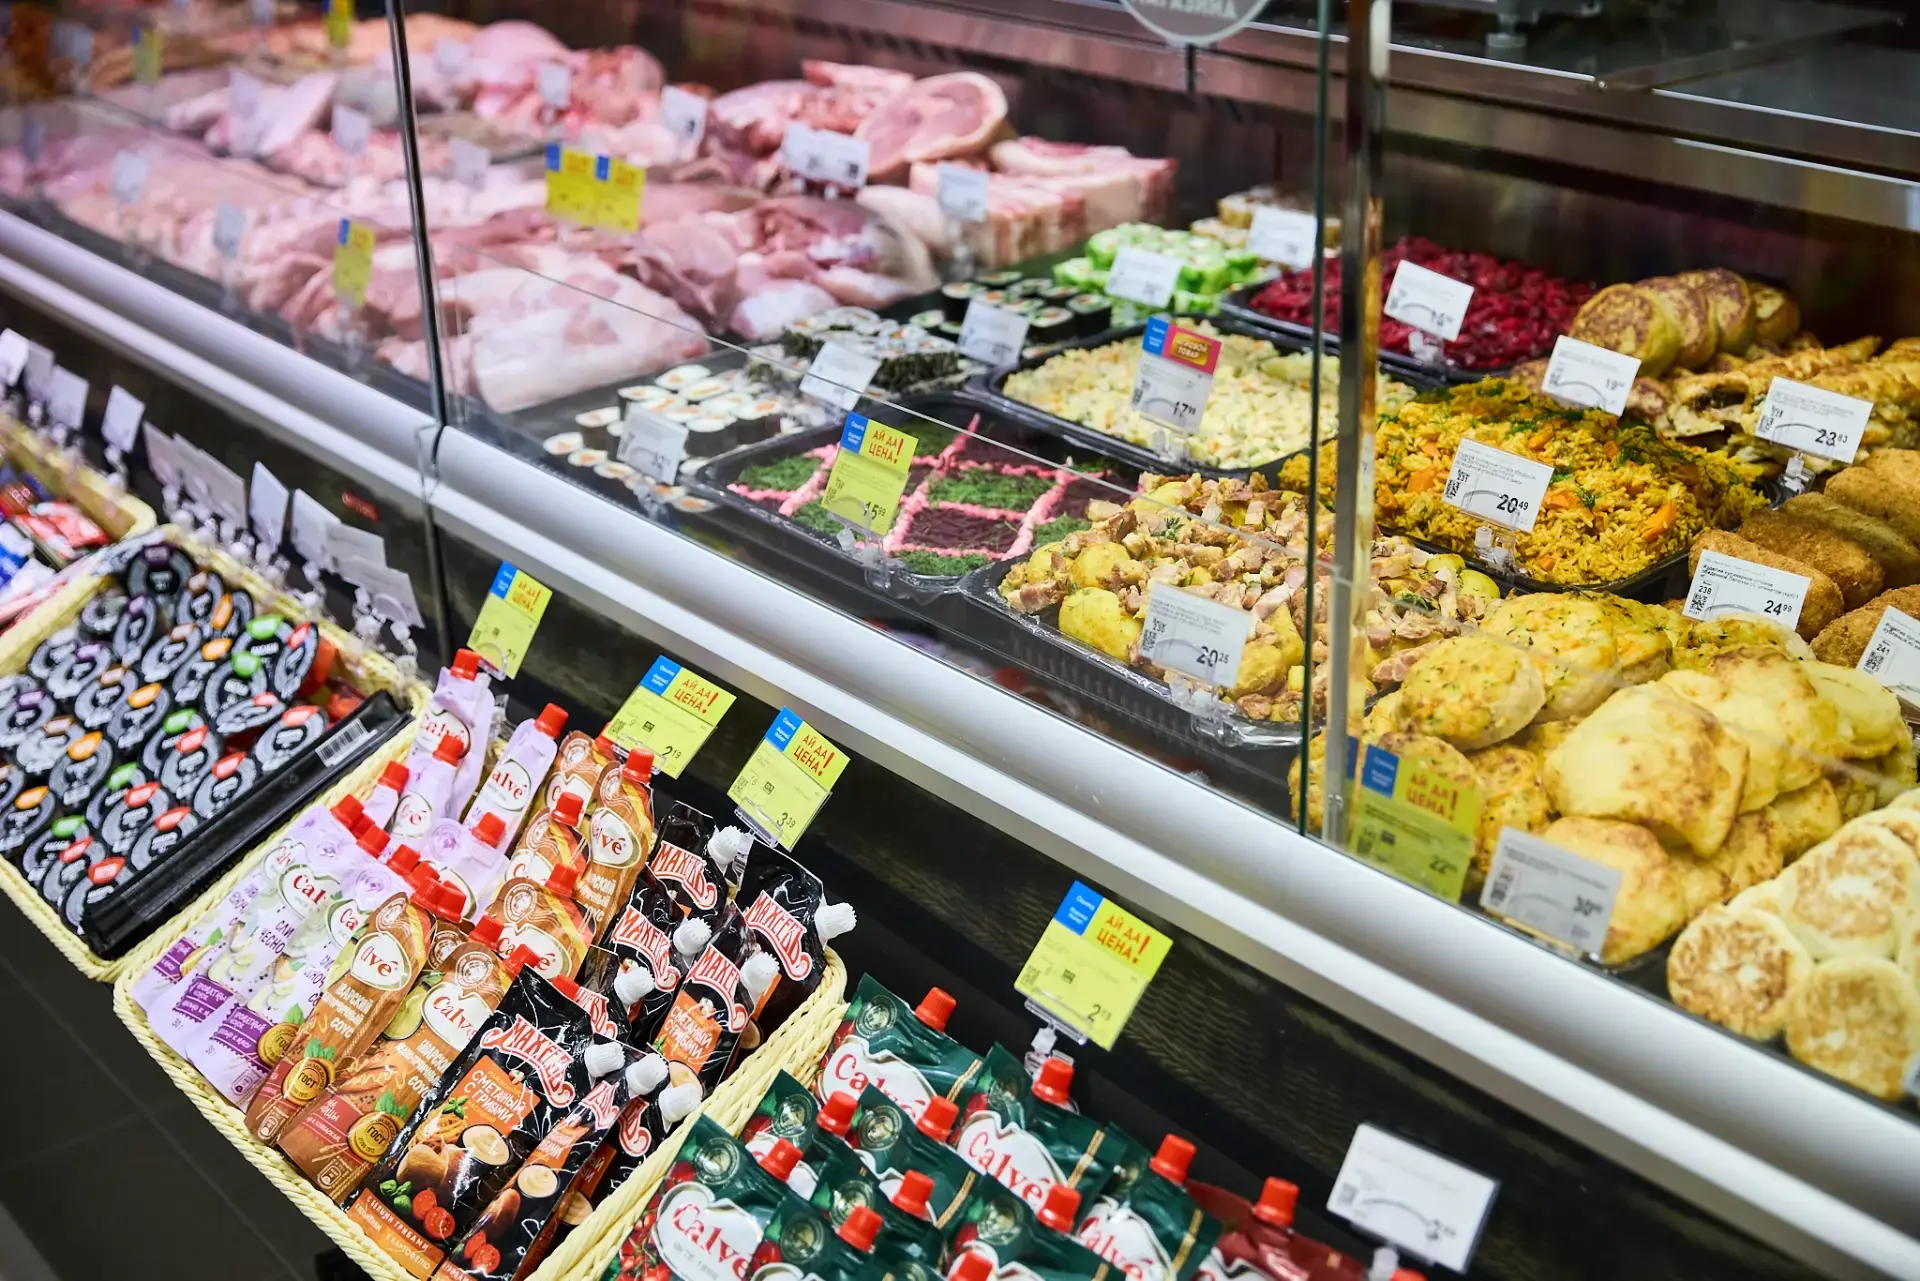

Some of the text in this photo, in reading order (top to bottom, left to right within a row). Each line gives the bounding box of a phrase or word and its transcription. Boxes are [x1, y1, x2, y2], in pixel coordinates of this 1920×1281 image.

[868, 438, 904, 464] ЦЕНА!
[873, 430, 886, 441] АЙ
[885, 436, 897, 447] ДА
[1698, 585, 1712, 595] 238
[1876, 643, 1890, 655] 241
[673, 689, 719, 714] ЦЕНА!
[683, 679, 711, 700] АЙ ДА
[802, 734, 828, 759] АЙ ДА
[793, 744, 835, 777] ЦЕНА!
[492, 772, 528, 800] alvé
[1106, 913, 1124, 929] АЙ
[1123, 927, 1140, 943] ДА
[1096, 928, 1151, 965] ЦЕНА!
[330, 1017, 355, 1038] СОУС
[298, 1072, 317, 1090] ГОСТ
[464, 1082, 476, 1094] С
[367, 1125, 387, 1146] ГОСТ
[969, 1131, 1049, 1199] Calvé
[394, 1220, 428, 1250] ГРИБАМИ
